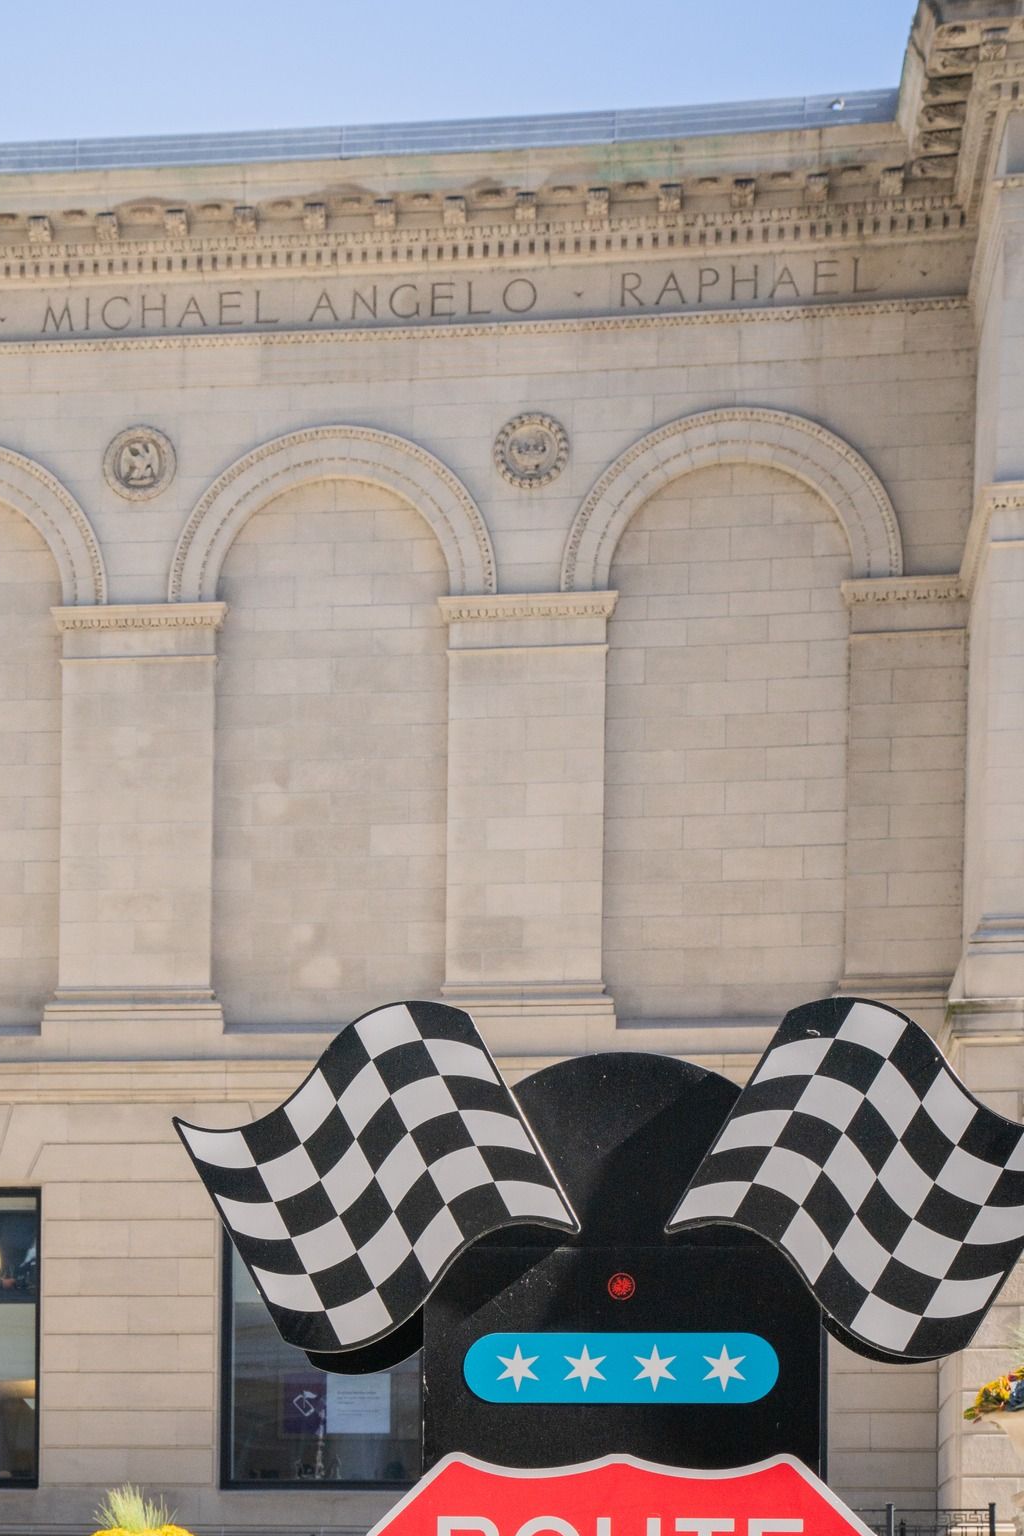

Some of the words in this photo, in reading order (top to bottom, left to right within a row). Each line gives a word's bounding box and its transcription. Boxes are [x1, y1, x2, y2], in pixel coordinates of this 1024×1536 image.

[39, 290, 280, 334] MICHAEL
[307, 277, 538, 322] ANGELO
[619, 256, 881, 308] RAPHAEL
